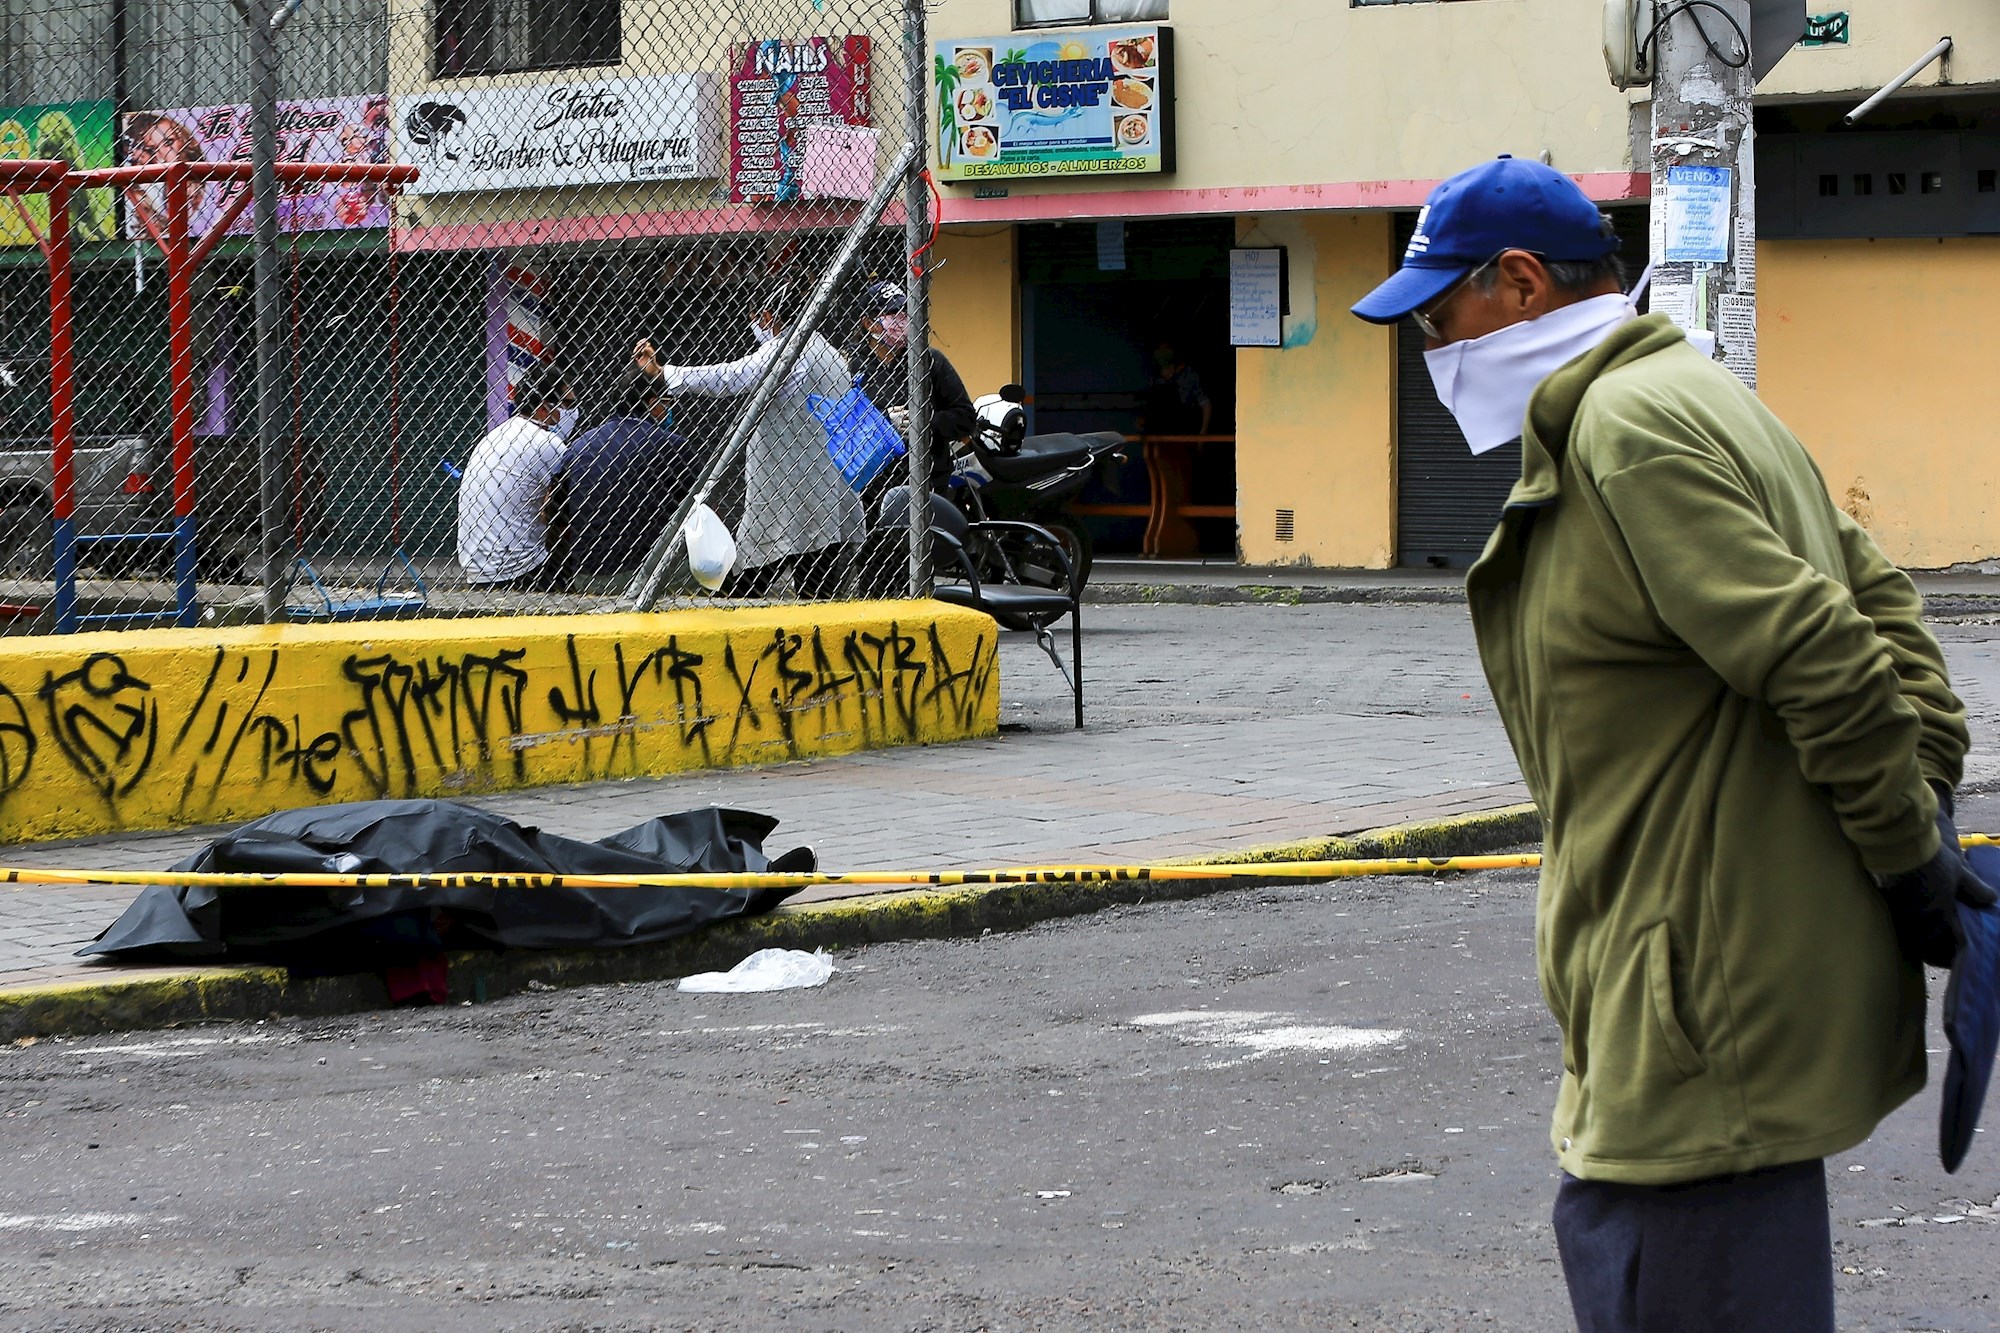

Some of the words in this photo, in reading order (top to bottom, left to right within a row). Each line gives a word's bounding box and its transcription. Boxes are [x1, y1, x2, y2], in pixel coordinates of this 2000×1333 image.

[755, 44, 828, 75] NAILS
[992, 57, 1114, 87] CEVICHERIA
[534, 88, 625, 131] Status
[469, 132, 551, 172] Barber
[552, 130, 573, 168] &
[964, 161, 1049, 177] DESAYUNOS
[1057, 157, 1147, 173] ALMUERZOS
[1676, 171, 1722, 182] VENDO
